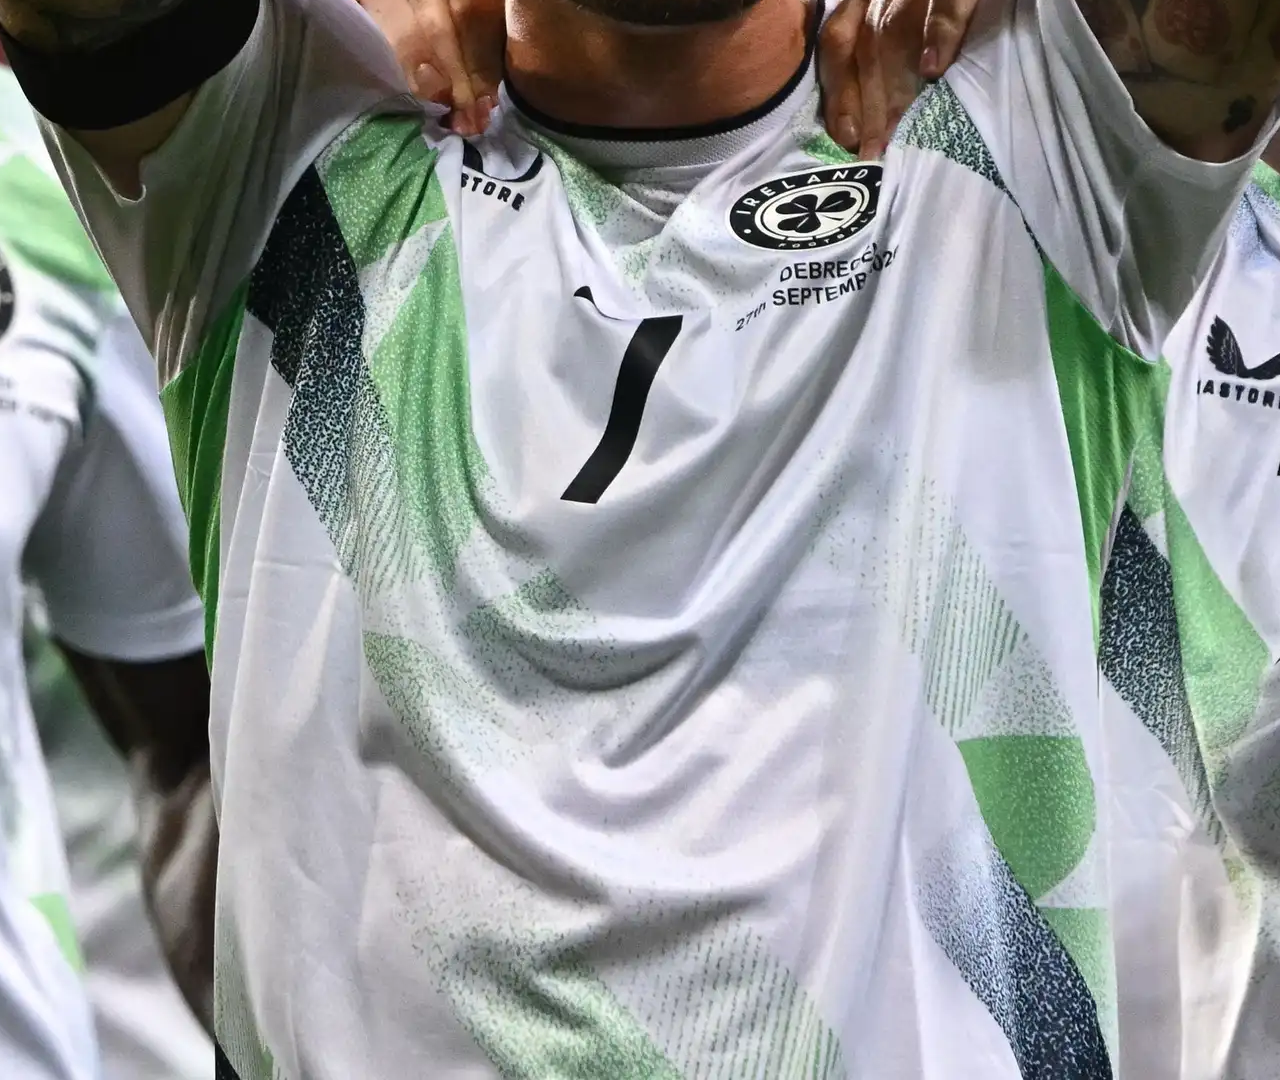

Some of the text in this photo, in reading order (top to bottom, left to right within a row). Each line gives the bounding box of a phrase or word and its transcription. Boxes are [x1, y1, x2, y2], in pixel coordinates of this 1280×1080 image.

[461, 172, 525, 212] STORE
[736, 169, 869, 215] IRELAND
[778, 209, 875, 248] FOOTBALL
[780, 242, 877, 283] DEBRECÉ
[772, 272, 867, 306] SEPTEMB
